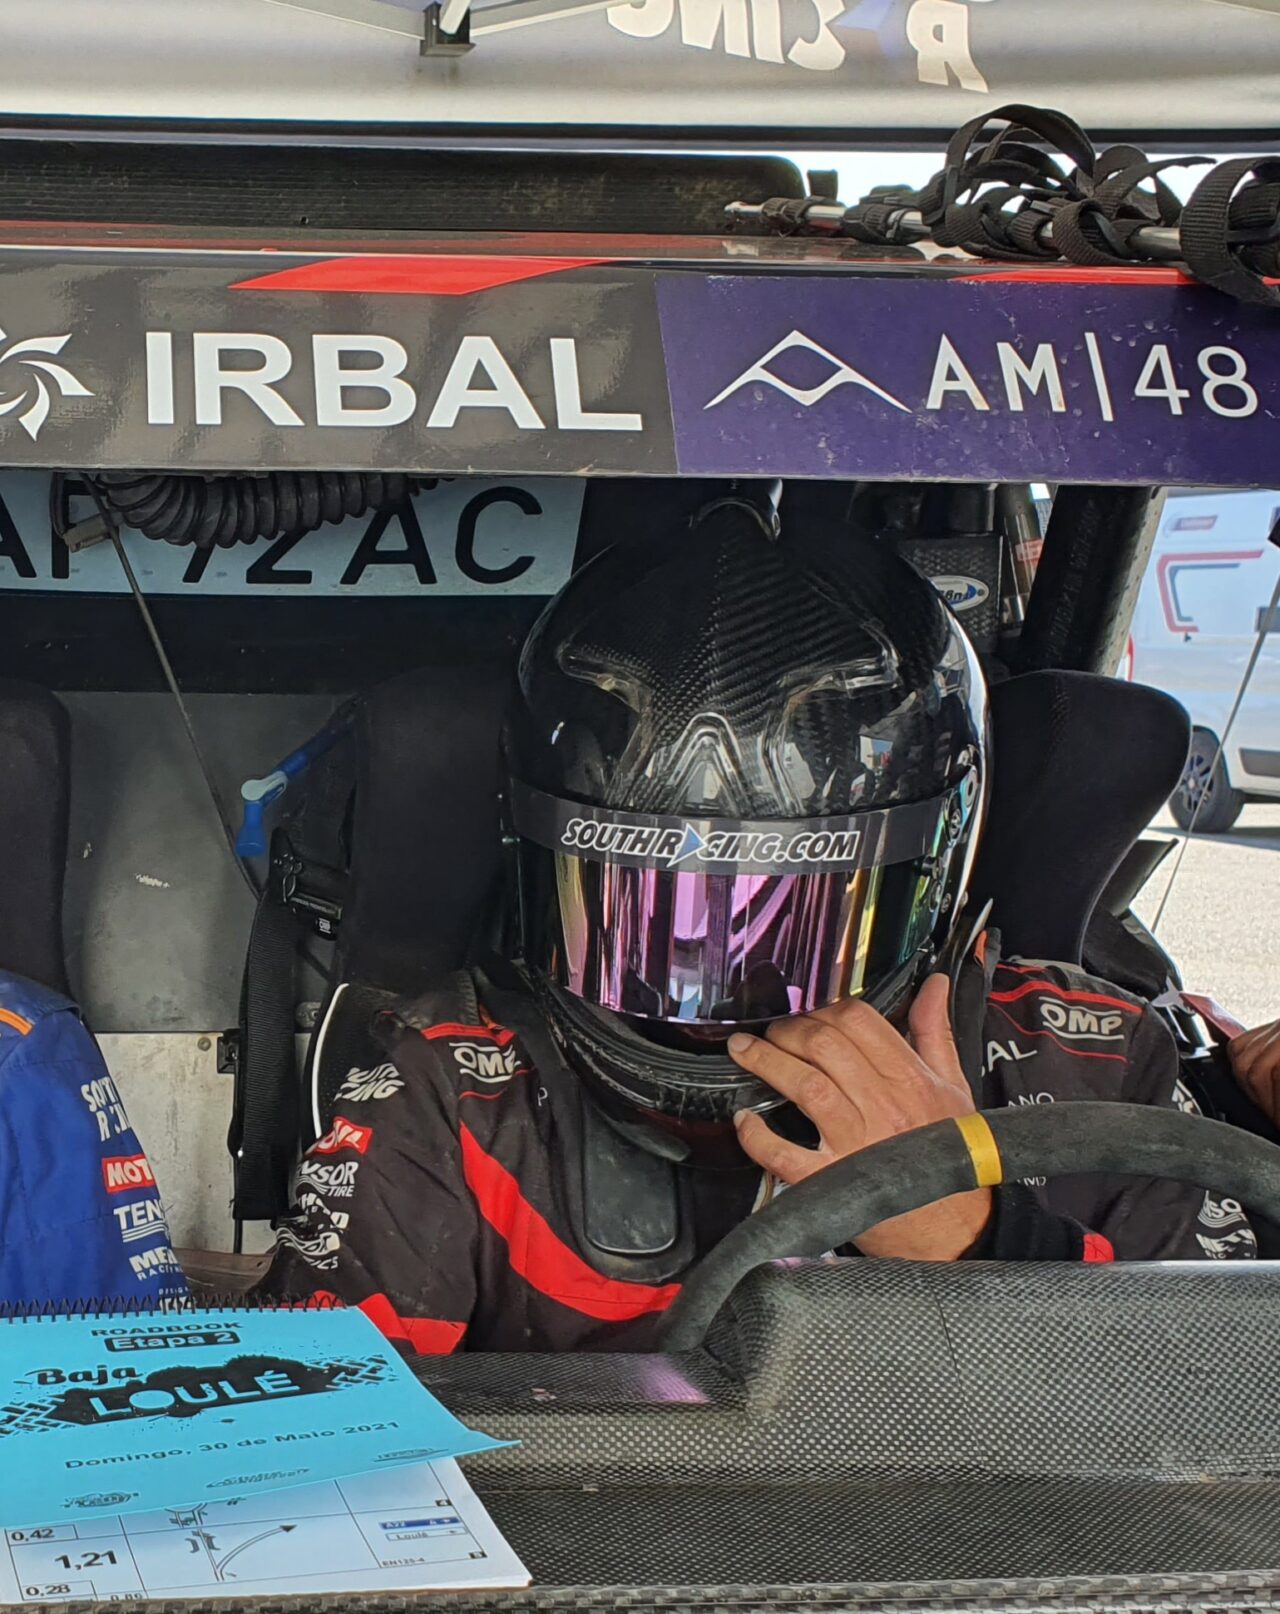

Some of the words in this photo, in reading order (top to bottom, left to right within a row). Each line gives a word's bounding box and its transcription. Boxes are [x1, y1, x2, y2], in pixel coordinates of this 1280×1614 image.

[146, 331, 643, 431] IRBAL
[339, 487, 544, 585] AC
[1040, 1003, 1123, 1035] OMP
[106, 1159, 152, 1187] MOT
[327, 1185, 355, 1197] TIRE
[113, 1199, 165, 1230] TEN
[90, 1321, 244, 1337] ROADBOOK
[111, 1333, 206, 1352] Etapa
[213, 1332, 234, 1345] 2
[25, 1364, 145, 1386] Baja
[89, 1369, 301, 1417] LOULÉ
[65, 1446, 192, 1470] Domingo,
[199, 1441, 228, 1453] 30
[237, 1435, 267, 1448] de
[275, 1428, 335, 1443] Maio
[341, 1421, 400, 1436] 2021
[11, 1528, 55, 1542] 0,42
[54, 1550, 118, 1571] 1,21
[25, 1584, 71, 1598] 0,28
